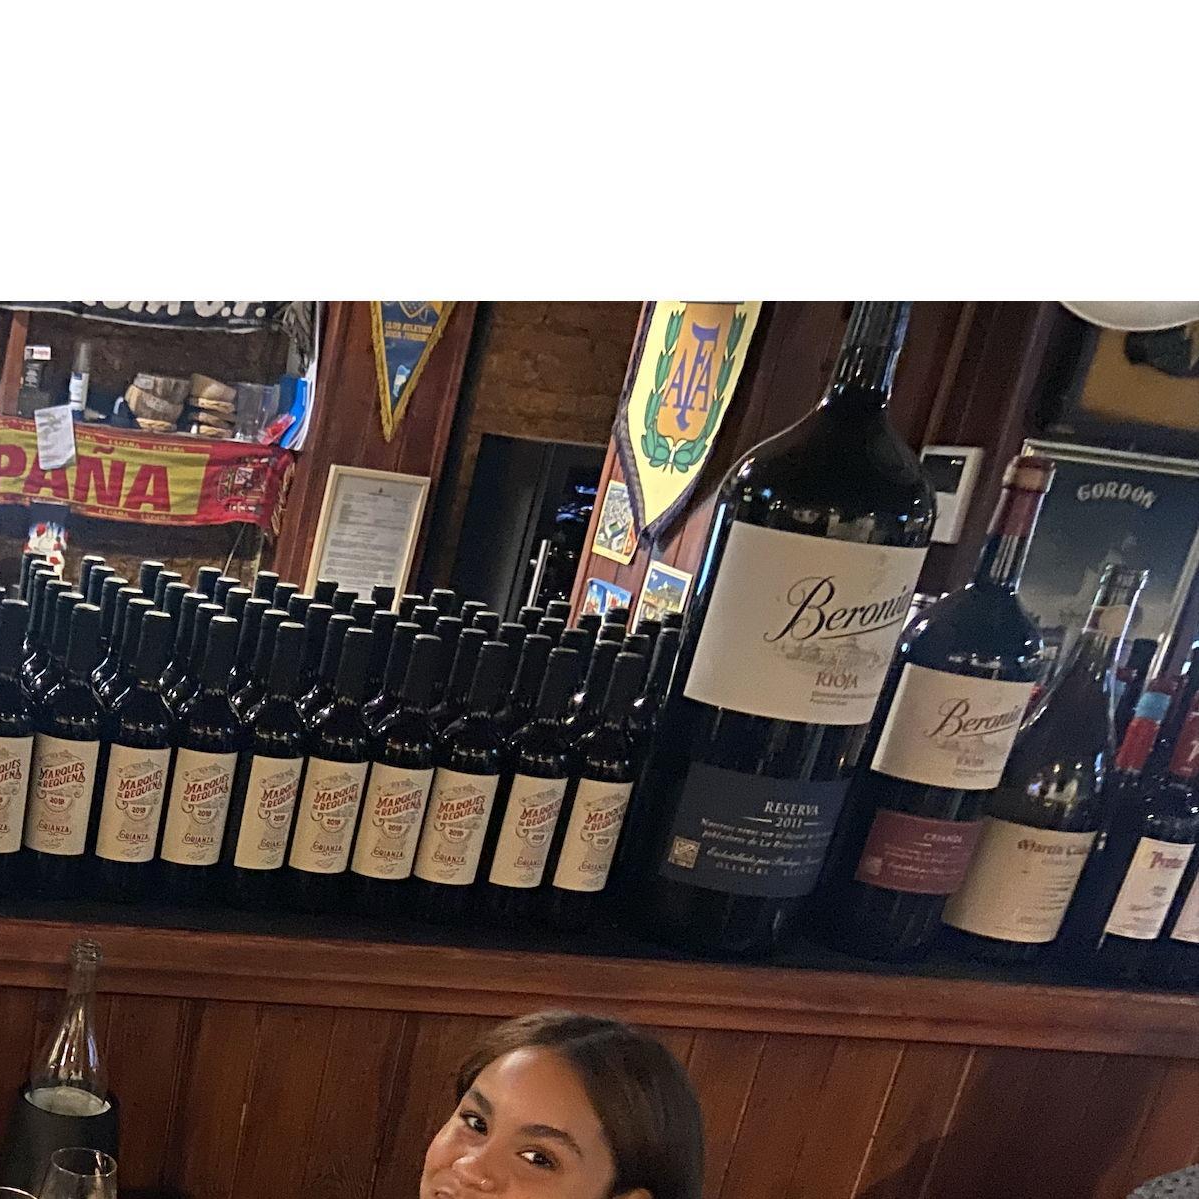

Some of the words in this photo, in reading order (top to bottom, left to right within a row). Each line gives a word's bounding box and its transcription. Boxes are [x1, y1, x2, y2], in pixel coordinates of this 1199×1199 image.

[1077, 481, 1158, 510] GORDON
[815, 671, 858, 690] RIOJA
[39, 762, 85, 780] MARQUES
[118, 769, 163, 792] MARQUES
[184, 773, 230, 795] MARQUES
[376, 789, 423, 808] MARQUES
[438, 795, 486, 813] MARQUES
[764, 801, 819, 816] RESERVA
[774, 817, 802, 828] 2011
